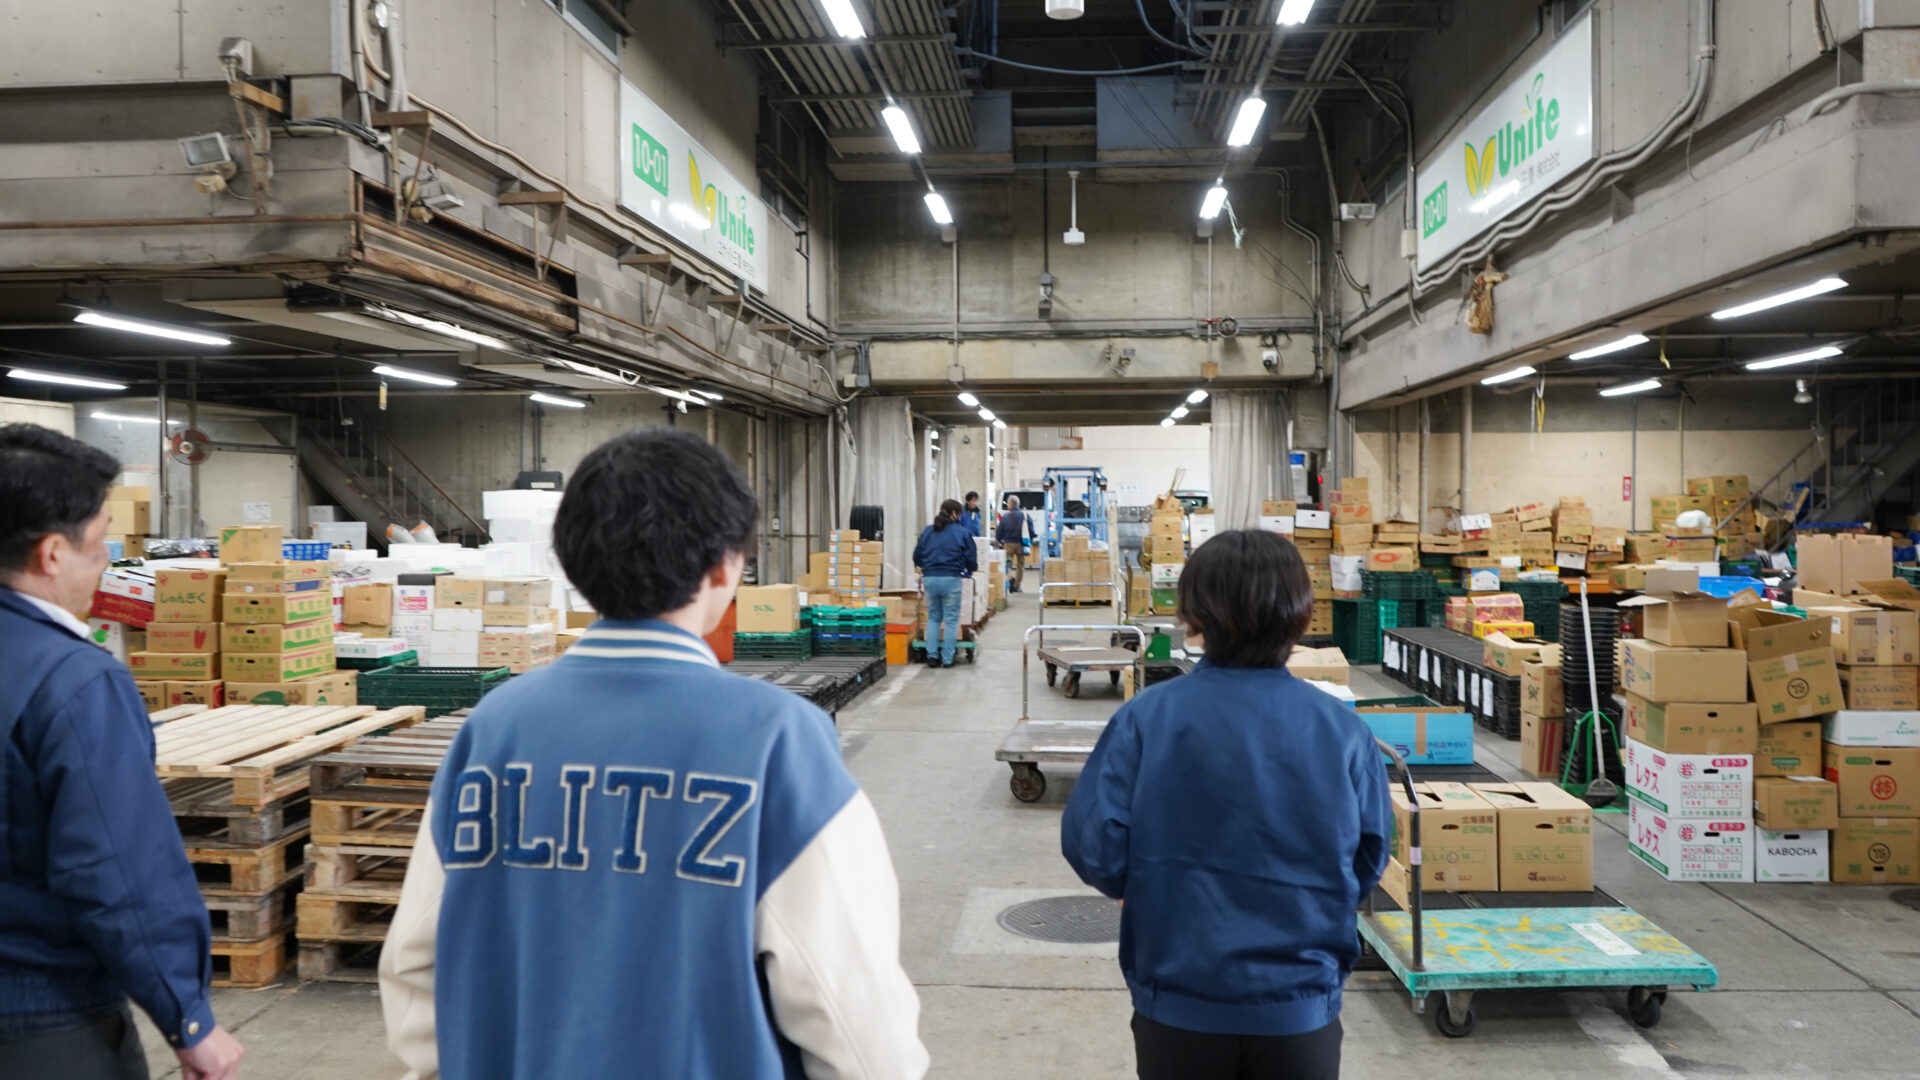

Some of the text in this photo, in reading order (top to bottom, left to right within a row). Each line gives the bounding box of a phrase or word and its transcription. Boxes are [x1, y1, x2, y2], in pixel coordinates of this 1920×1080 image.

[1498, 97, 1560, 178] Unite
[634, 133, 667, 188] 10-01
[718, 189, 755, 256] Unite
[1424, 190, 1447, 232] 10-01
[1636, 762, 1660, 795] レタス
[1722, 773, 1742, 781] レタス
[444, 762, 758, 888] BLITZ
[1638, 822, 1661, 857] レタス
[1722, 836, 1742, 844] レタス
[1768, 847, 1817, 857] KABOCHA
